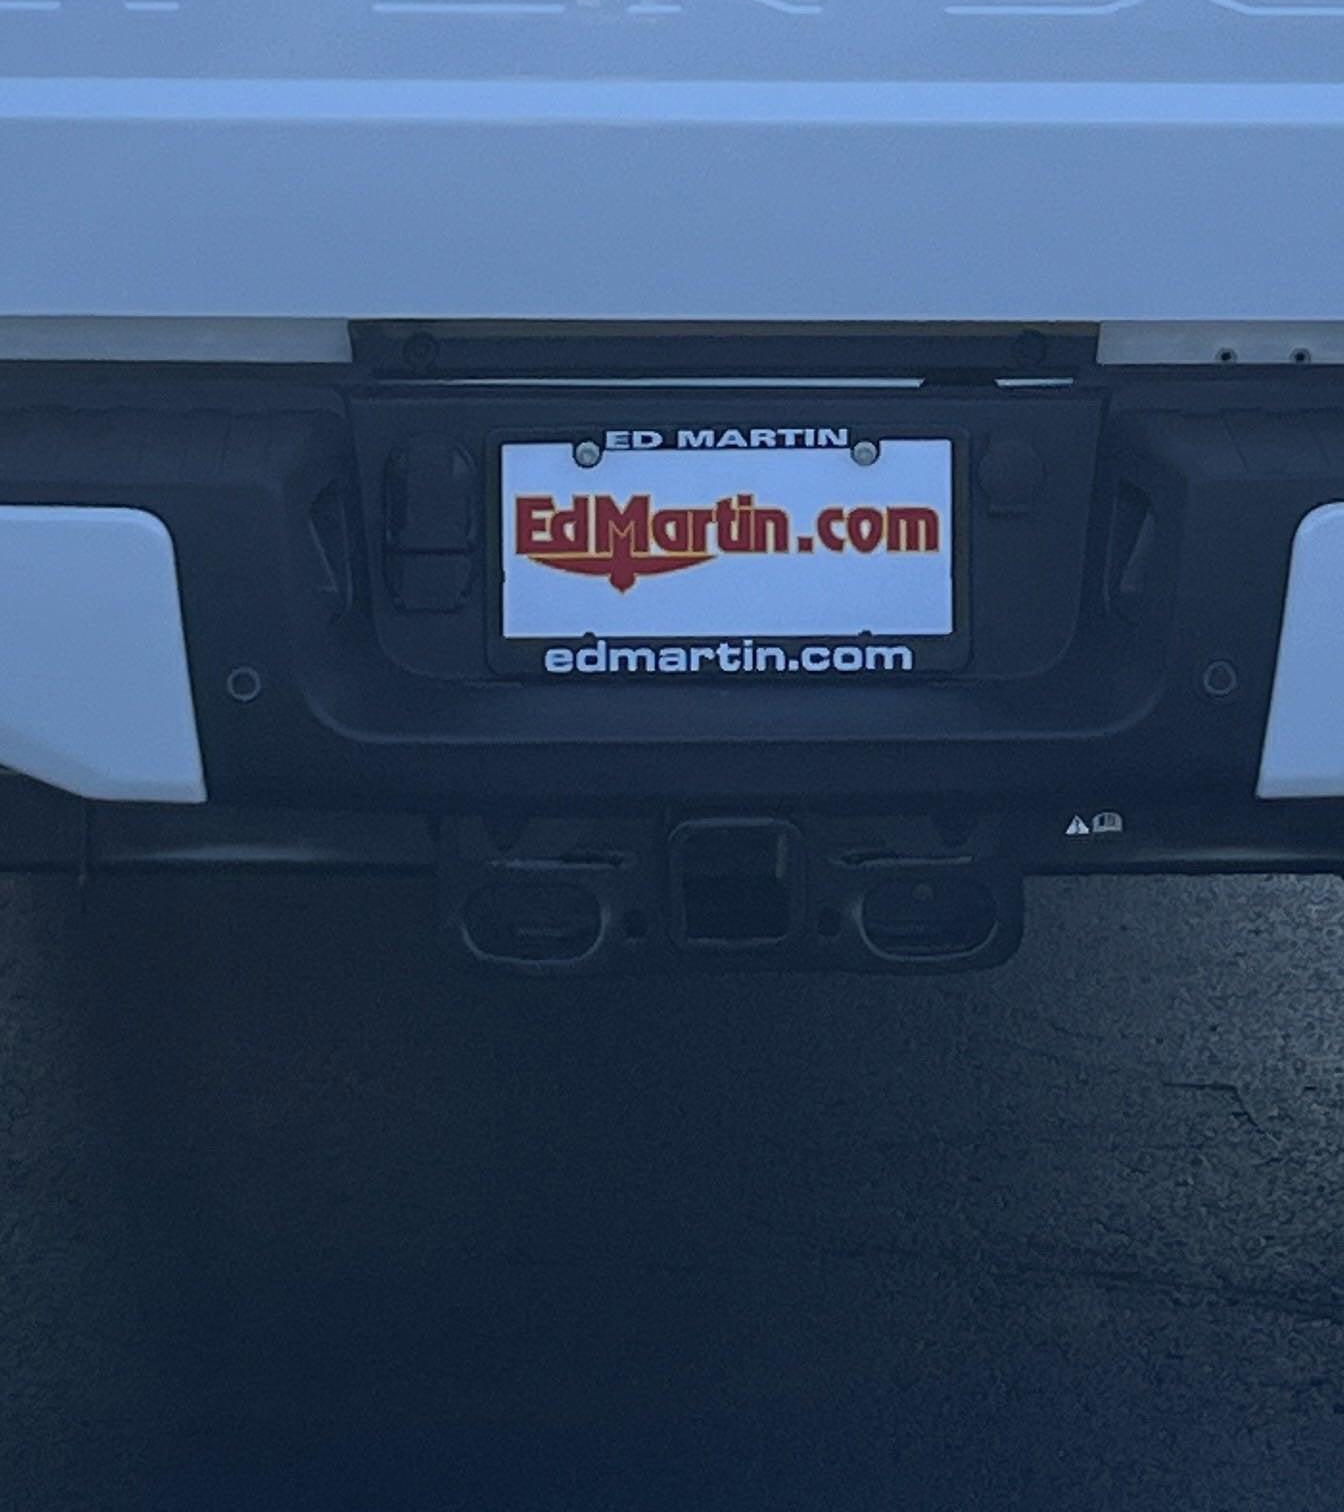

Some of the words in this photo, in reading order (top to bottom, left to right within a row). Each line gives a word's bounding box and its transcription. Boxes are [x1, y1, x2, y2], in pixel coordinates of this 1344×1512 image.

[605, 431, 662, 449] ED
[677, 428, 848, 448] MARTIN
[515, 494, 939, 555] EdMartin.com
[545, 641, 913, 672] edmartin.com
